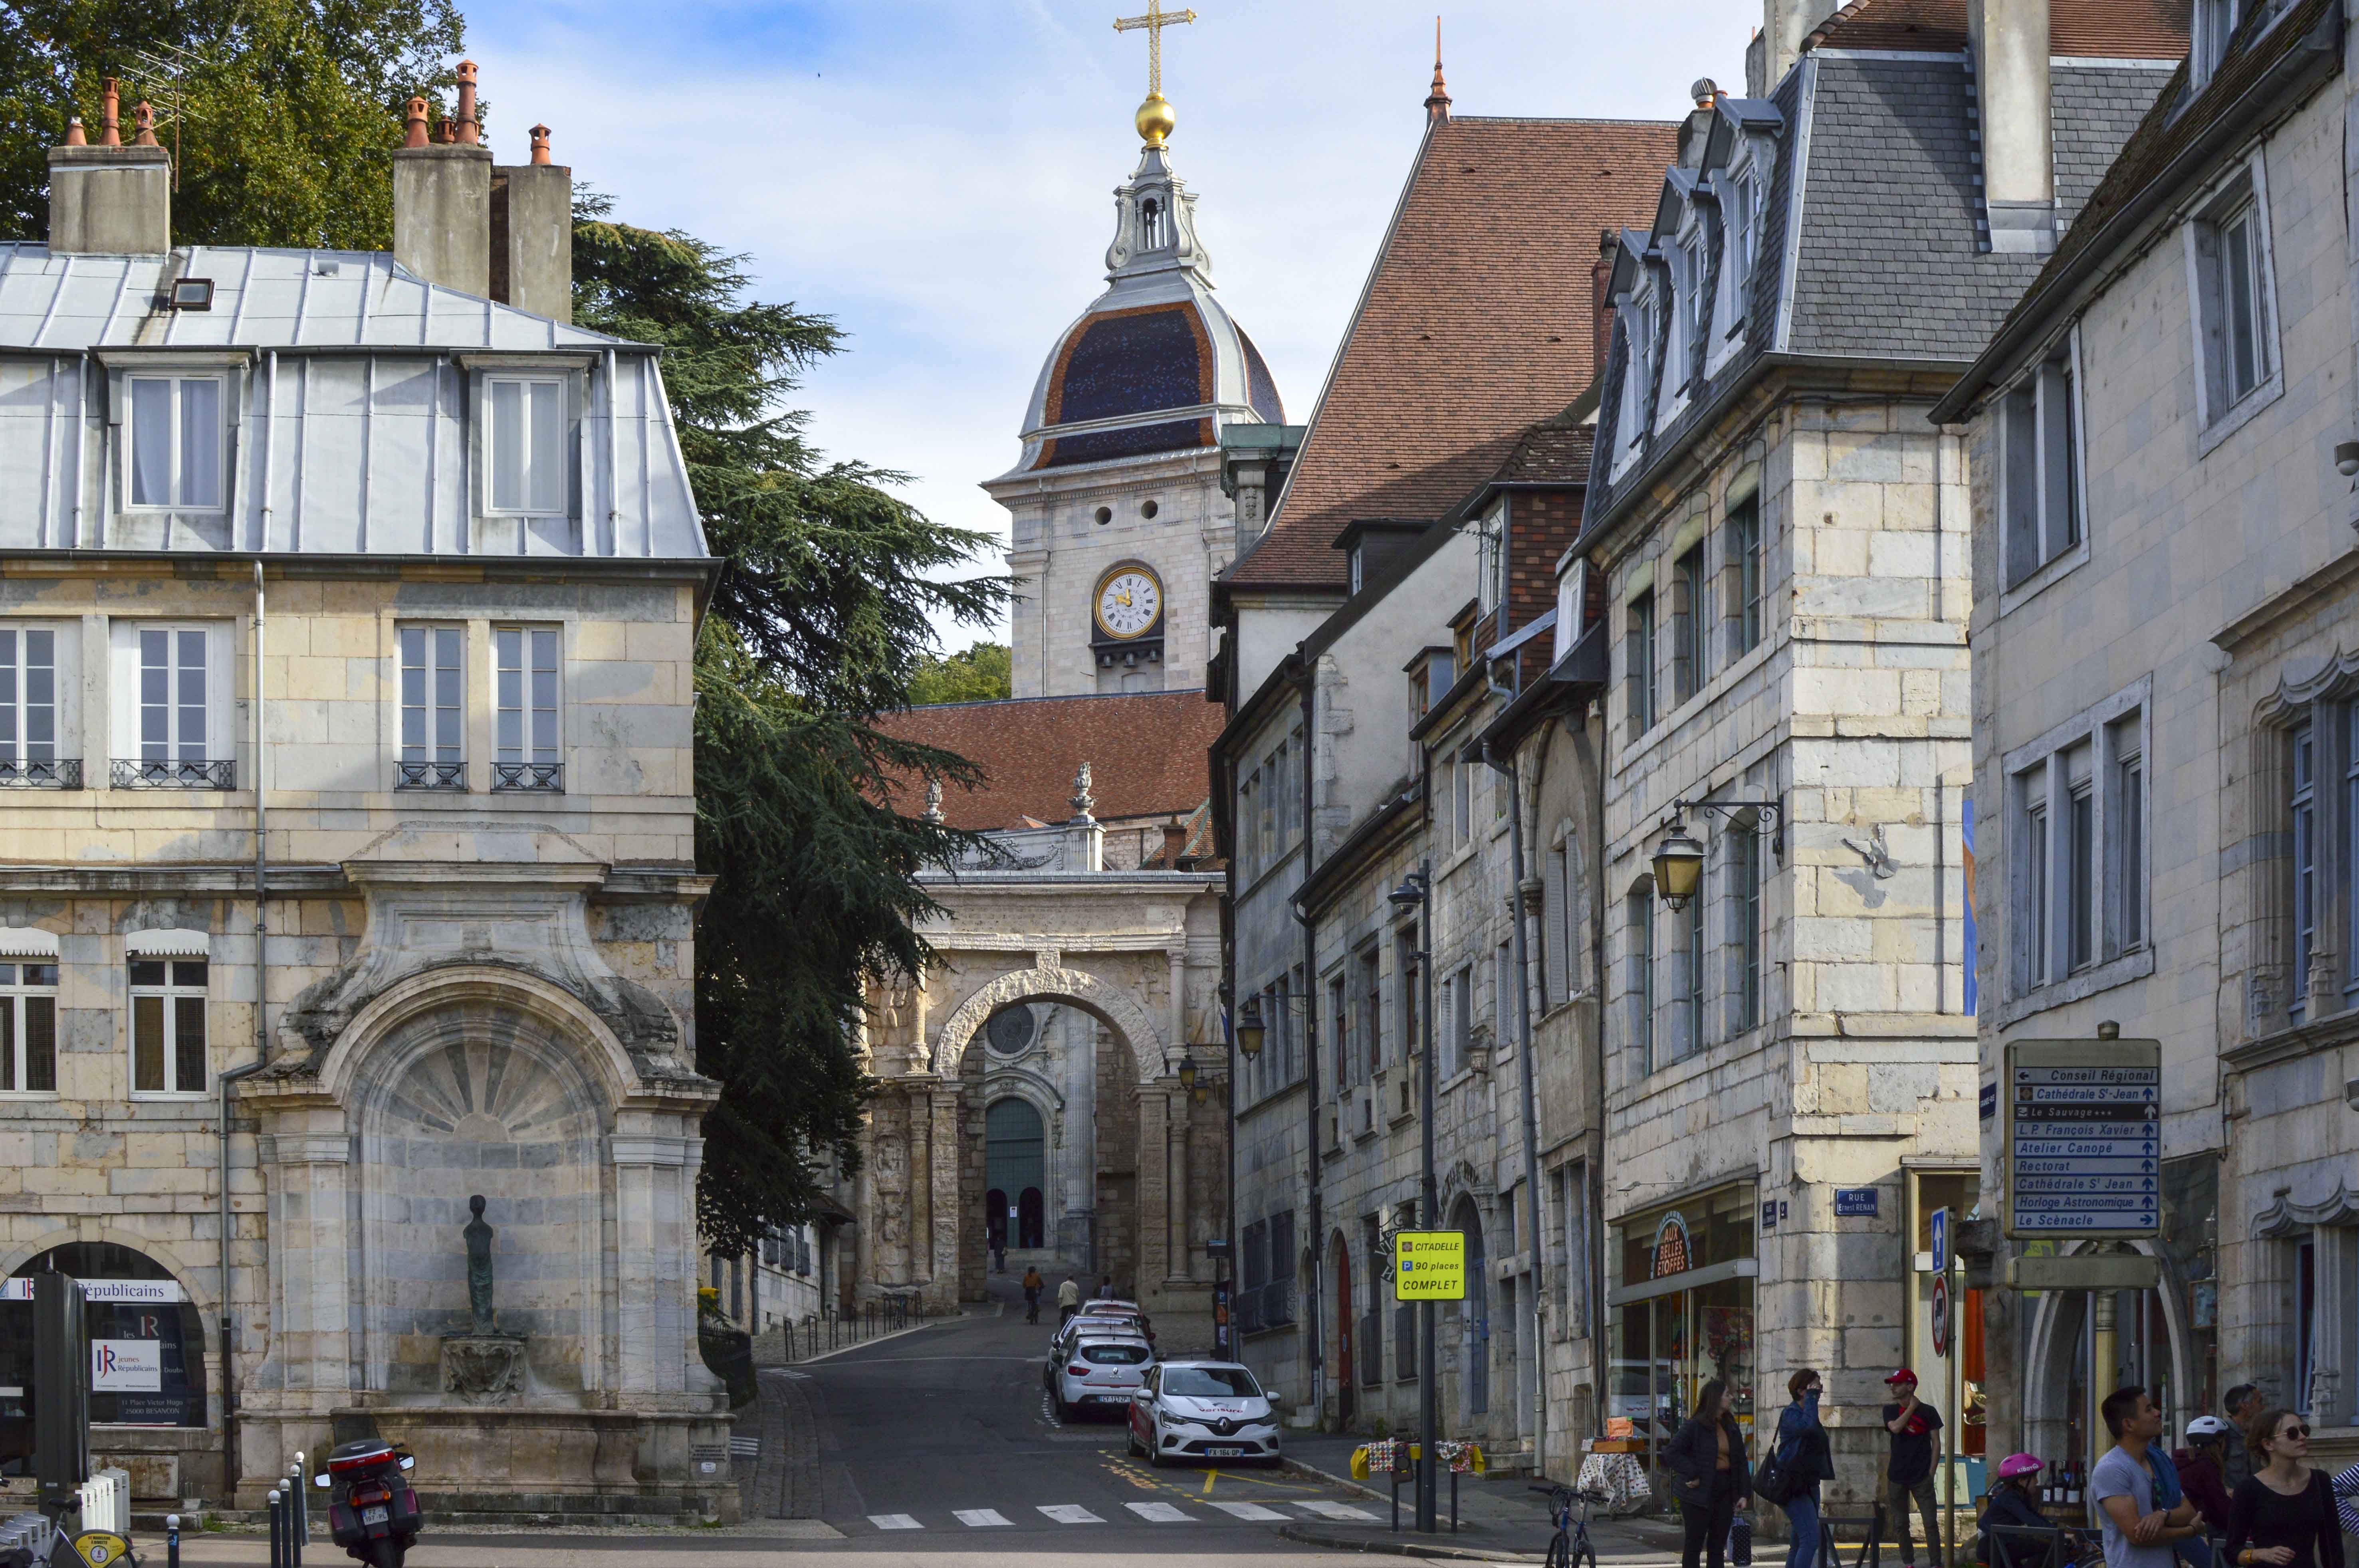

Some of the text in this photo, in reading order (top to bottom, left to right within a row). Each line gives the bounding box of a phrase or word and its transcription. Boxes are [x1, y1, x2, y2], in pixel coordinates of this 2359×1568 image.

[2051, 1070, 2153, 1083] Conseil Régional
[2037, 1088, 2095, 1099] Cathédrale
[2046, 1125, 2094, 1136] François
[2099, 1125, 2135, 1134] Xavier
[2020, 1142, 2112, 1156] Atelier Canopé
[2019, 1161, 2070, 1171] Rectorat
[2019, 1178, 2085, 1189] Cathédrale
[2105, 1179, 2133, 1189] Jean
[2020, 1196, 2134, 1210] Horloge Astronomique
[2020, 1215, 2032, 1225] Le
[1664, 1226, 1678, 1243] AUX
[1660, 1239, 1683, 1260] BELLES
[1431, 1262, 1459, 1271] places
[1657, 1255, 1685, 1276] ETOFFES
[78, 1283, 164, 1299] épublicains
[1404, 1280, 1457, 1290] COMPLET
